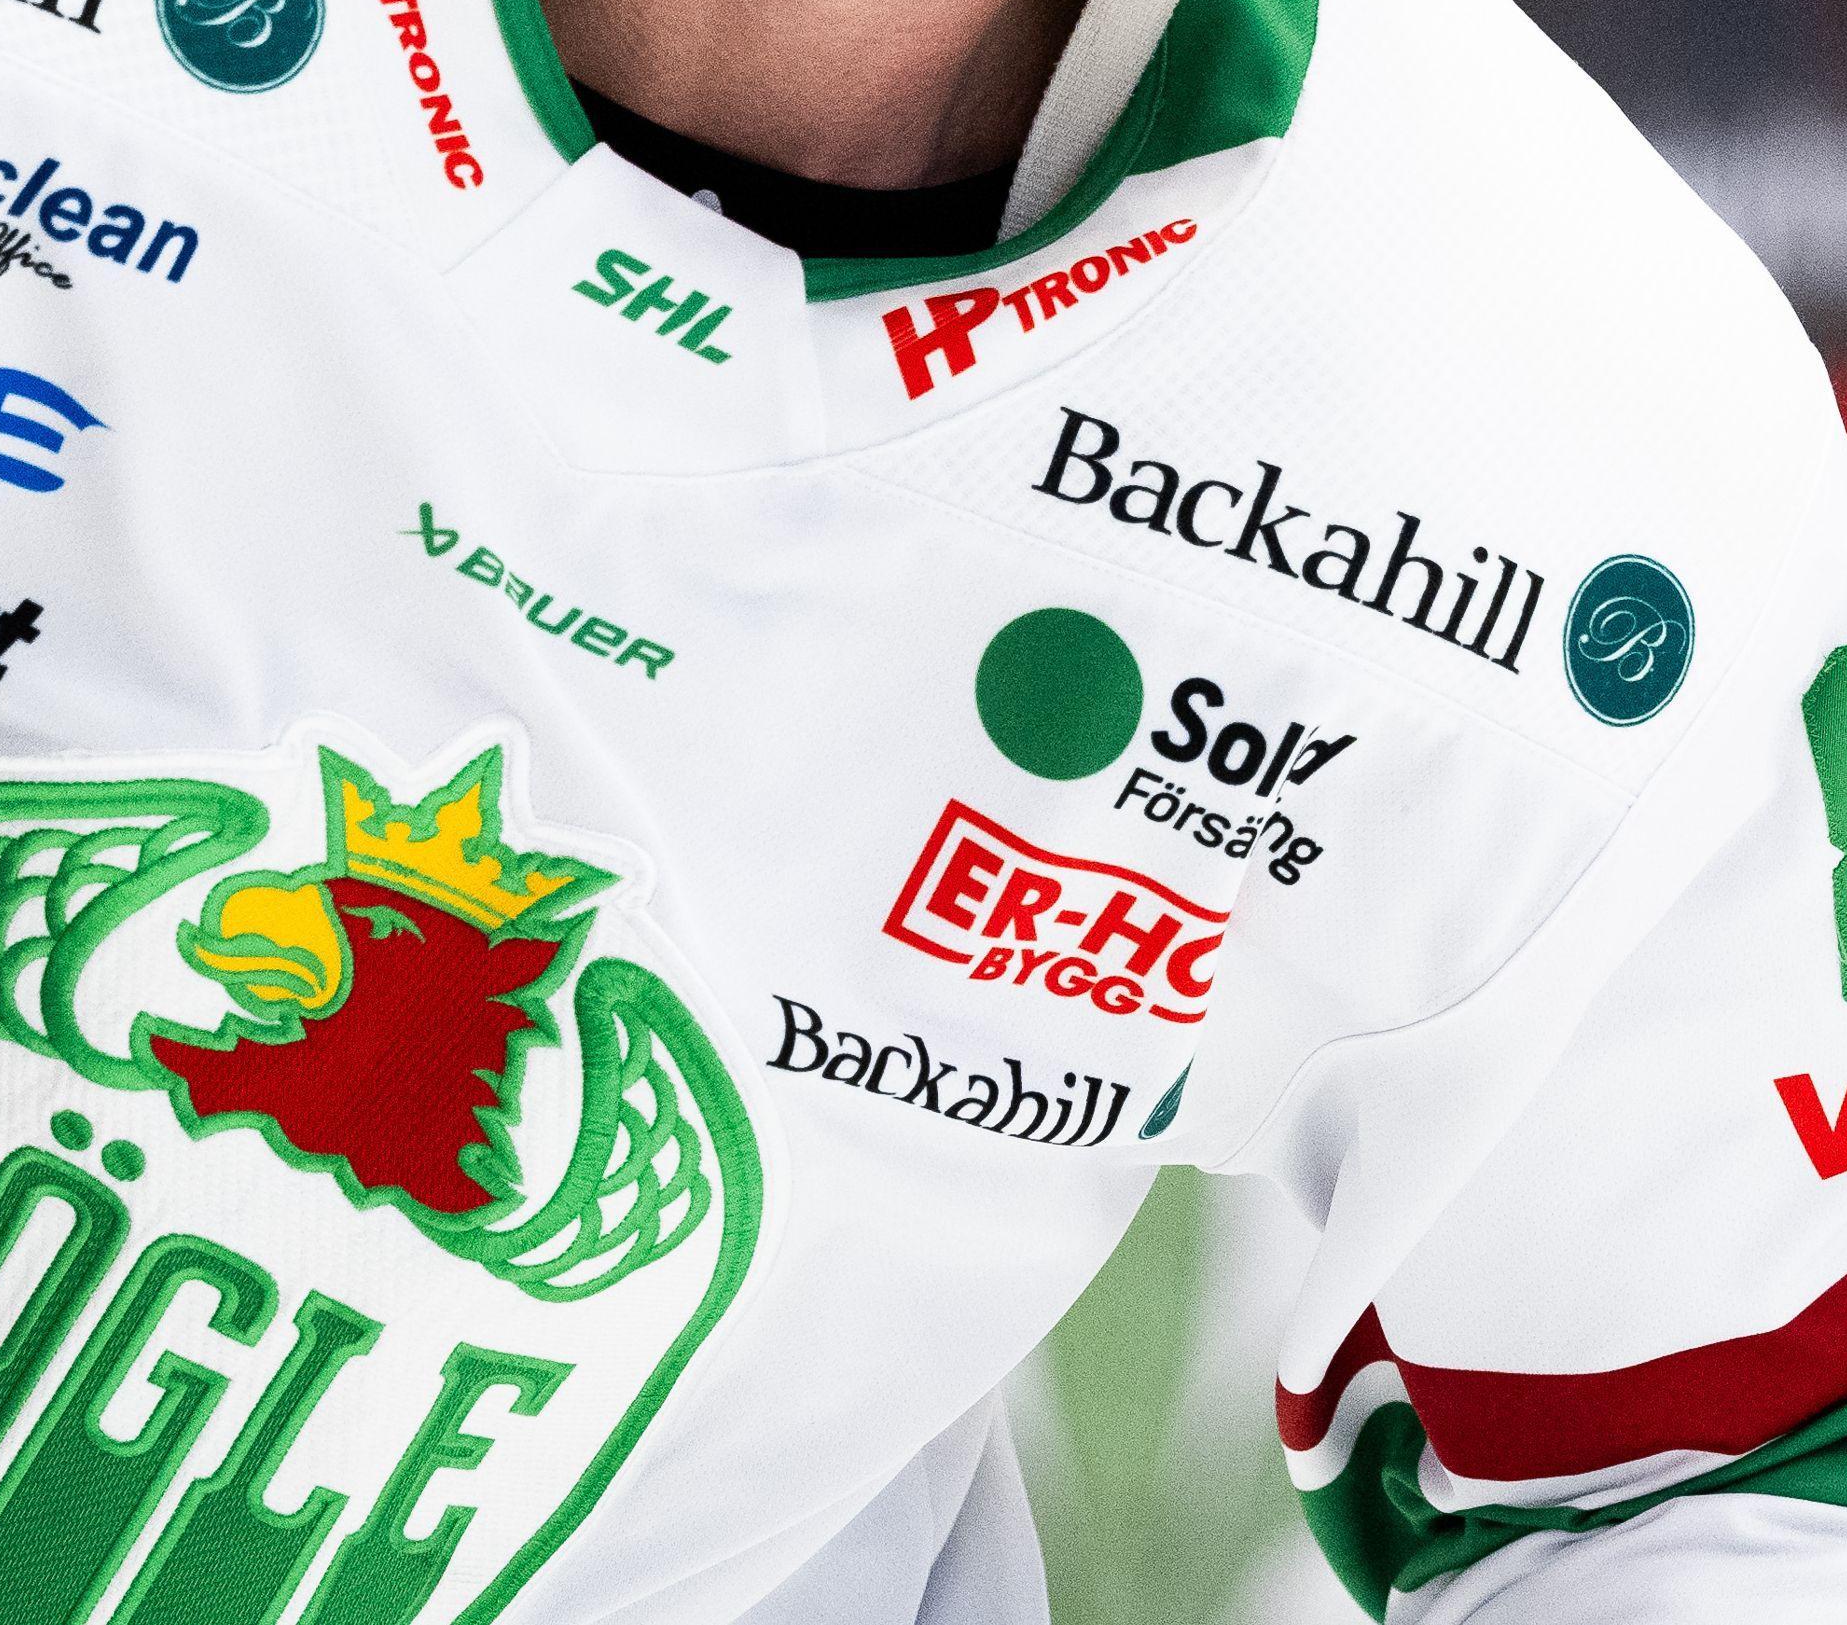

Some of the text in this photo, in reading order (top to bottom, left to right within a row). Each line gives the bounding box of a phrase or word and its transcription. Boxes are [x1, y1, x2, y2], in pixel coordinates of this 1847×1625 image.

[571, 248, 733, 366] SHL
[881, 217, 1199, 401] HP TRONIC
[1031, 405, 1545, 675] Backahill
[455, 545, 676, 681] BAUER
[1150, 676, 1358, 798] Sold
[968, 946, 1145, 1016] BYGG
[765, 993, 1132, 1148] Backahill
